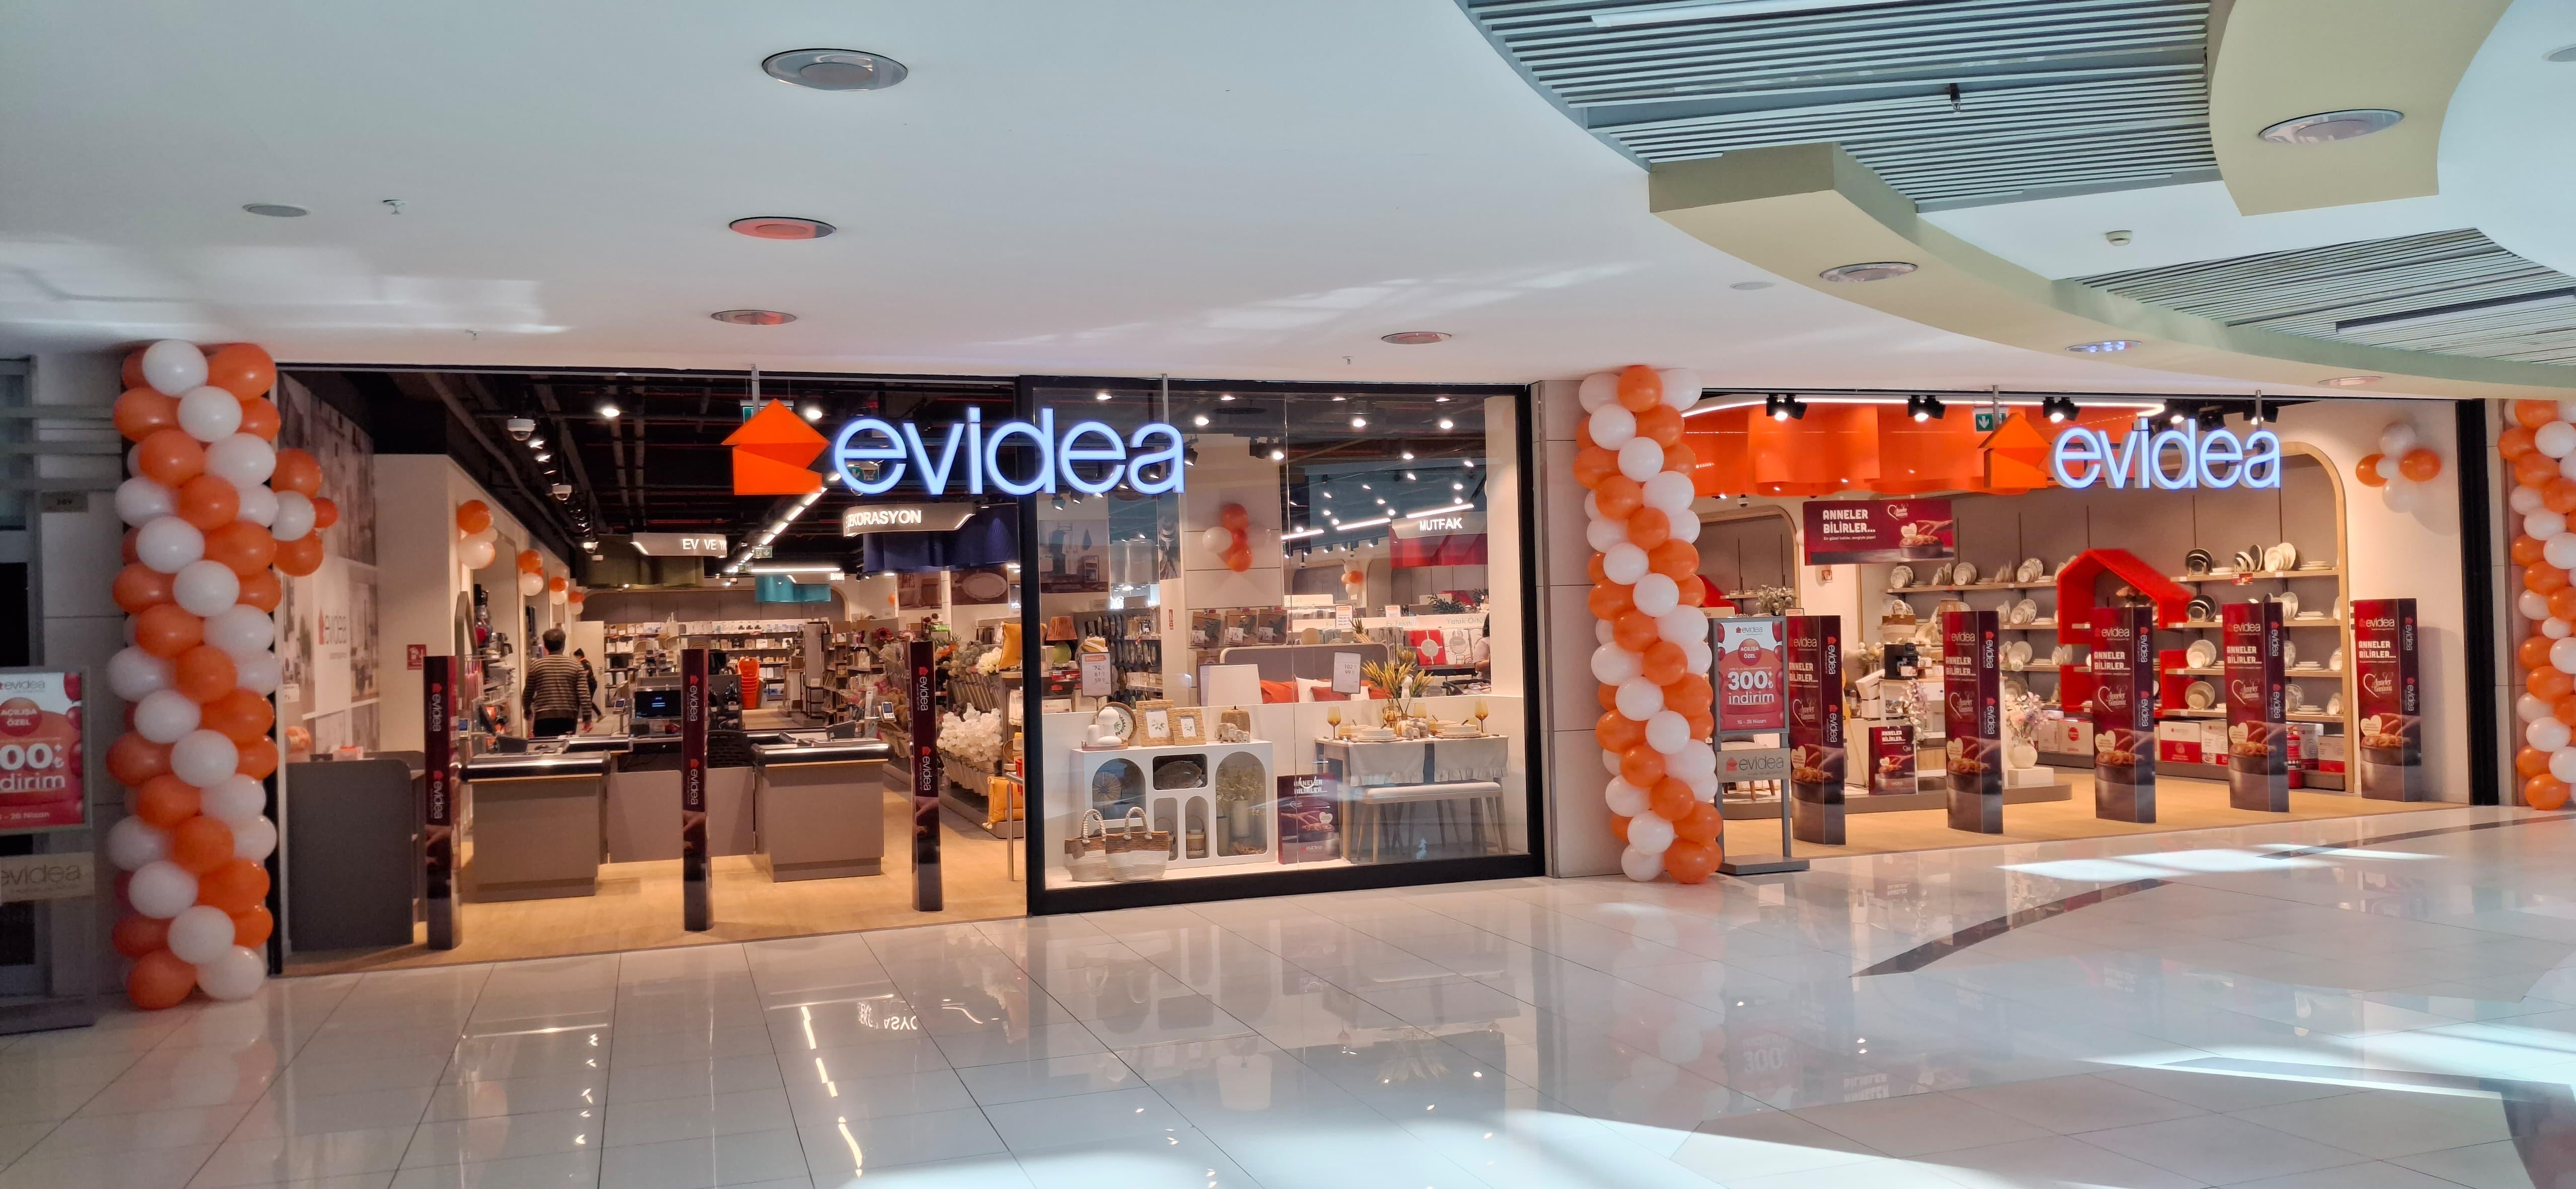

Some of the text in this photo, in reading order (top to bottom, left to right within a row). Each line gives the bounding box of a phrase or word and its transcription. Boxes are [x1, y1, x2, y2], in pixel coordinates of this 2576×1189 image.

[835, 407, 1185, 495] evidea
[2052, 417, 2281, 489] evidea
[1420, 518, 1463, 532] MUTFAK
[1823, 509, 1868, 520] ANNELER
[1823, 522, 1876, 534] BİLİRLER...
[682, 538, 700, 550] EV
[703, 539, 717, 550] VE
[2102, 627, 2130, 637] evidea
[2234, 622, 2261, 632] evidea
[2366, 618, 2395, 627] evidea
[1794, 637, 1817, 647] evidea
[1952, 632, 1975, 641] evidea
[2272, 629, 2280, 656] evidea
[2405, 625, 2413, 650] evidea
[1986, 640, 1994, 668] evidea
[2094, 651, 2125, 659] ANNELER
[2140, 635, 2148, 662] evidea
[1789, 662, 1813, 671] ANNELER
[1828, 645, 1837, 674] evidea
[1946, 656, 1972, 665] ANNELER
[4, 680, 45, 690] evidea
[919, 676, 929, 711] evidea
[690, 685, 699, 722] evidea
[1728, 692, 1774, 705] indirim
[2274, 692, 2282, 718] evidea
[7, 718, 32, 726] ÖZEL
[432, 694, 442, 731] evidea
[1987, 706, 1996, 734] evidea
[2141, 699, 2149, 727] evidea
[1829, 713, 1838, 742] evidea
[921, 756, 931, 791] evidea
[1739, 756, 1784, 771] evidea
[0, 773, 65, 791] dirim
[691, 769, 700, 805] evidea
[434, 781, 444, 819] evidea
[0, 865, 81, 886] evidea
